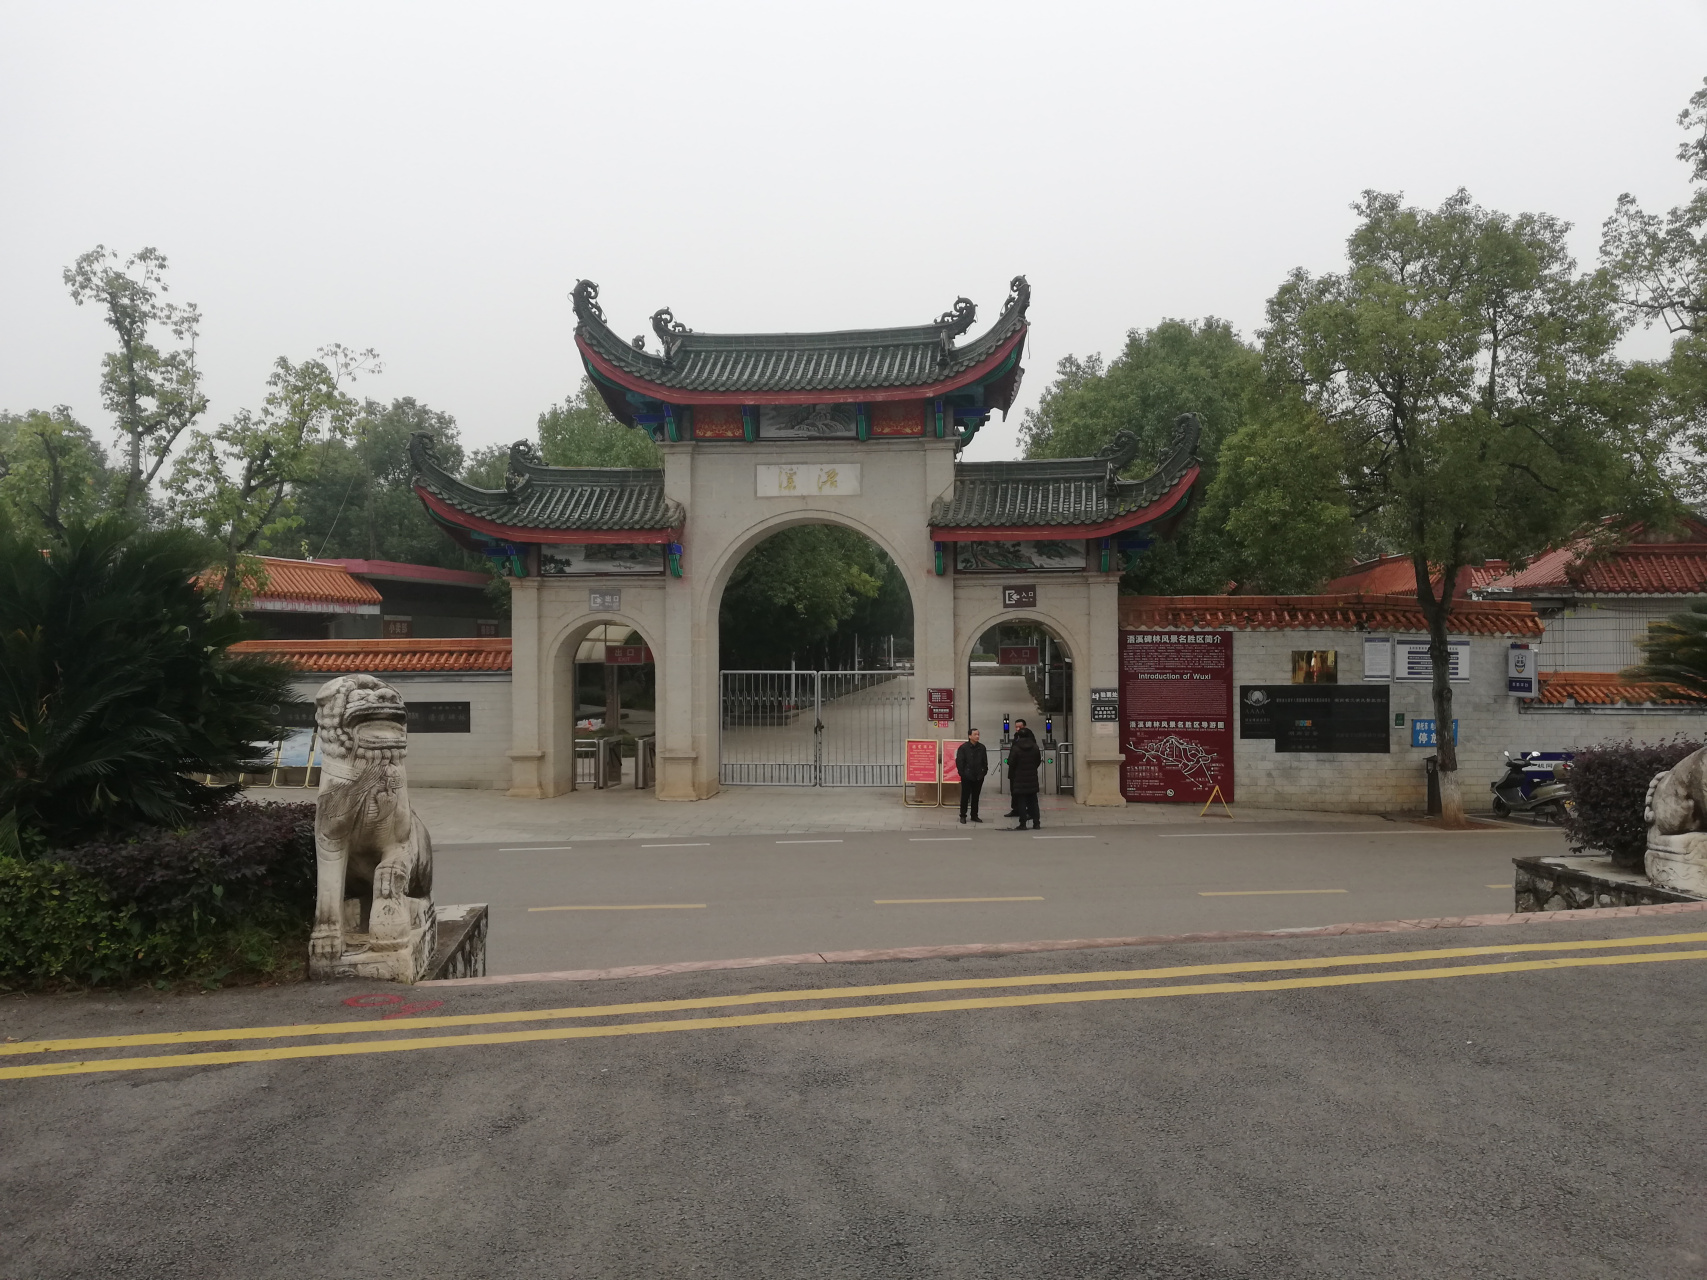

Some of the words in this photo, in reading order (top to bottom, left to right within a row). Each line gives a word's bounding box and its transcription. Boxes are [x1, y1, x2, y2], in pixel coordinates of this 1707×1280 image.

[1126, 634, 1222, 644] 浯溪碑林风景名胜区简介
[614, 648, 635, 657] 出口
[1009, 650, 1030, 658] 入口
